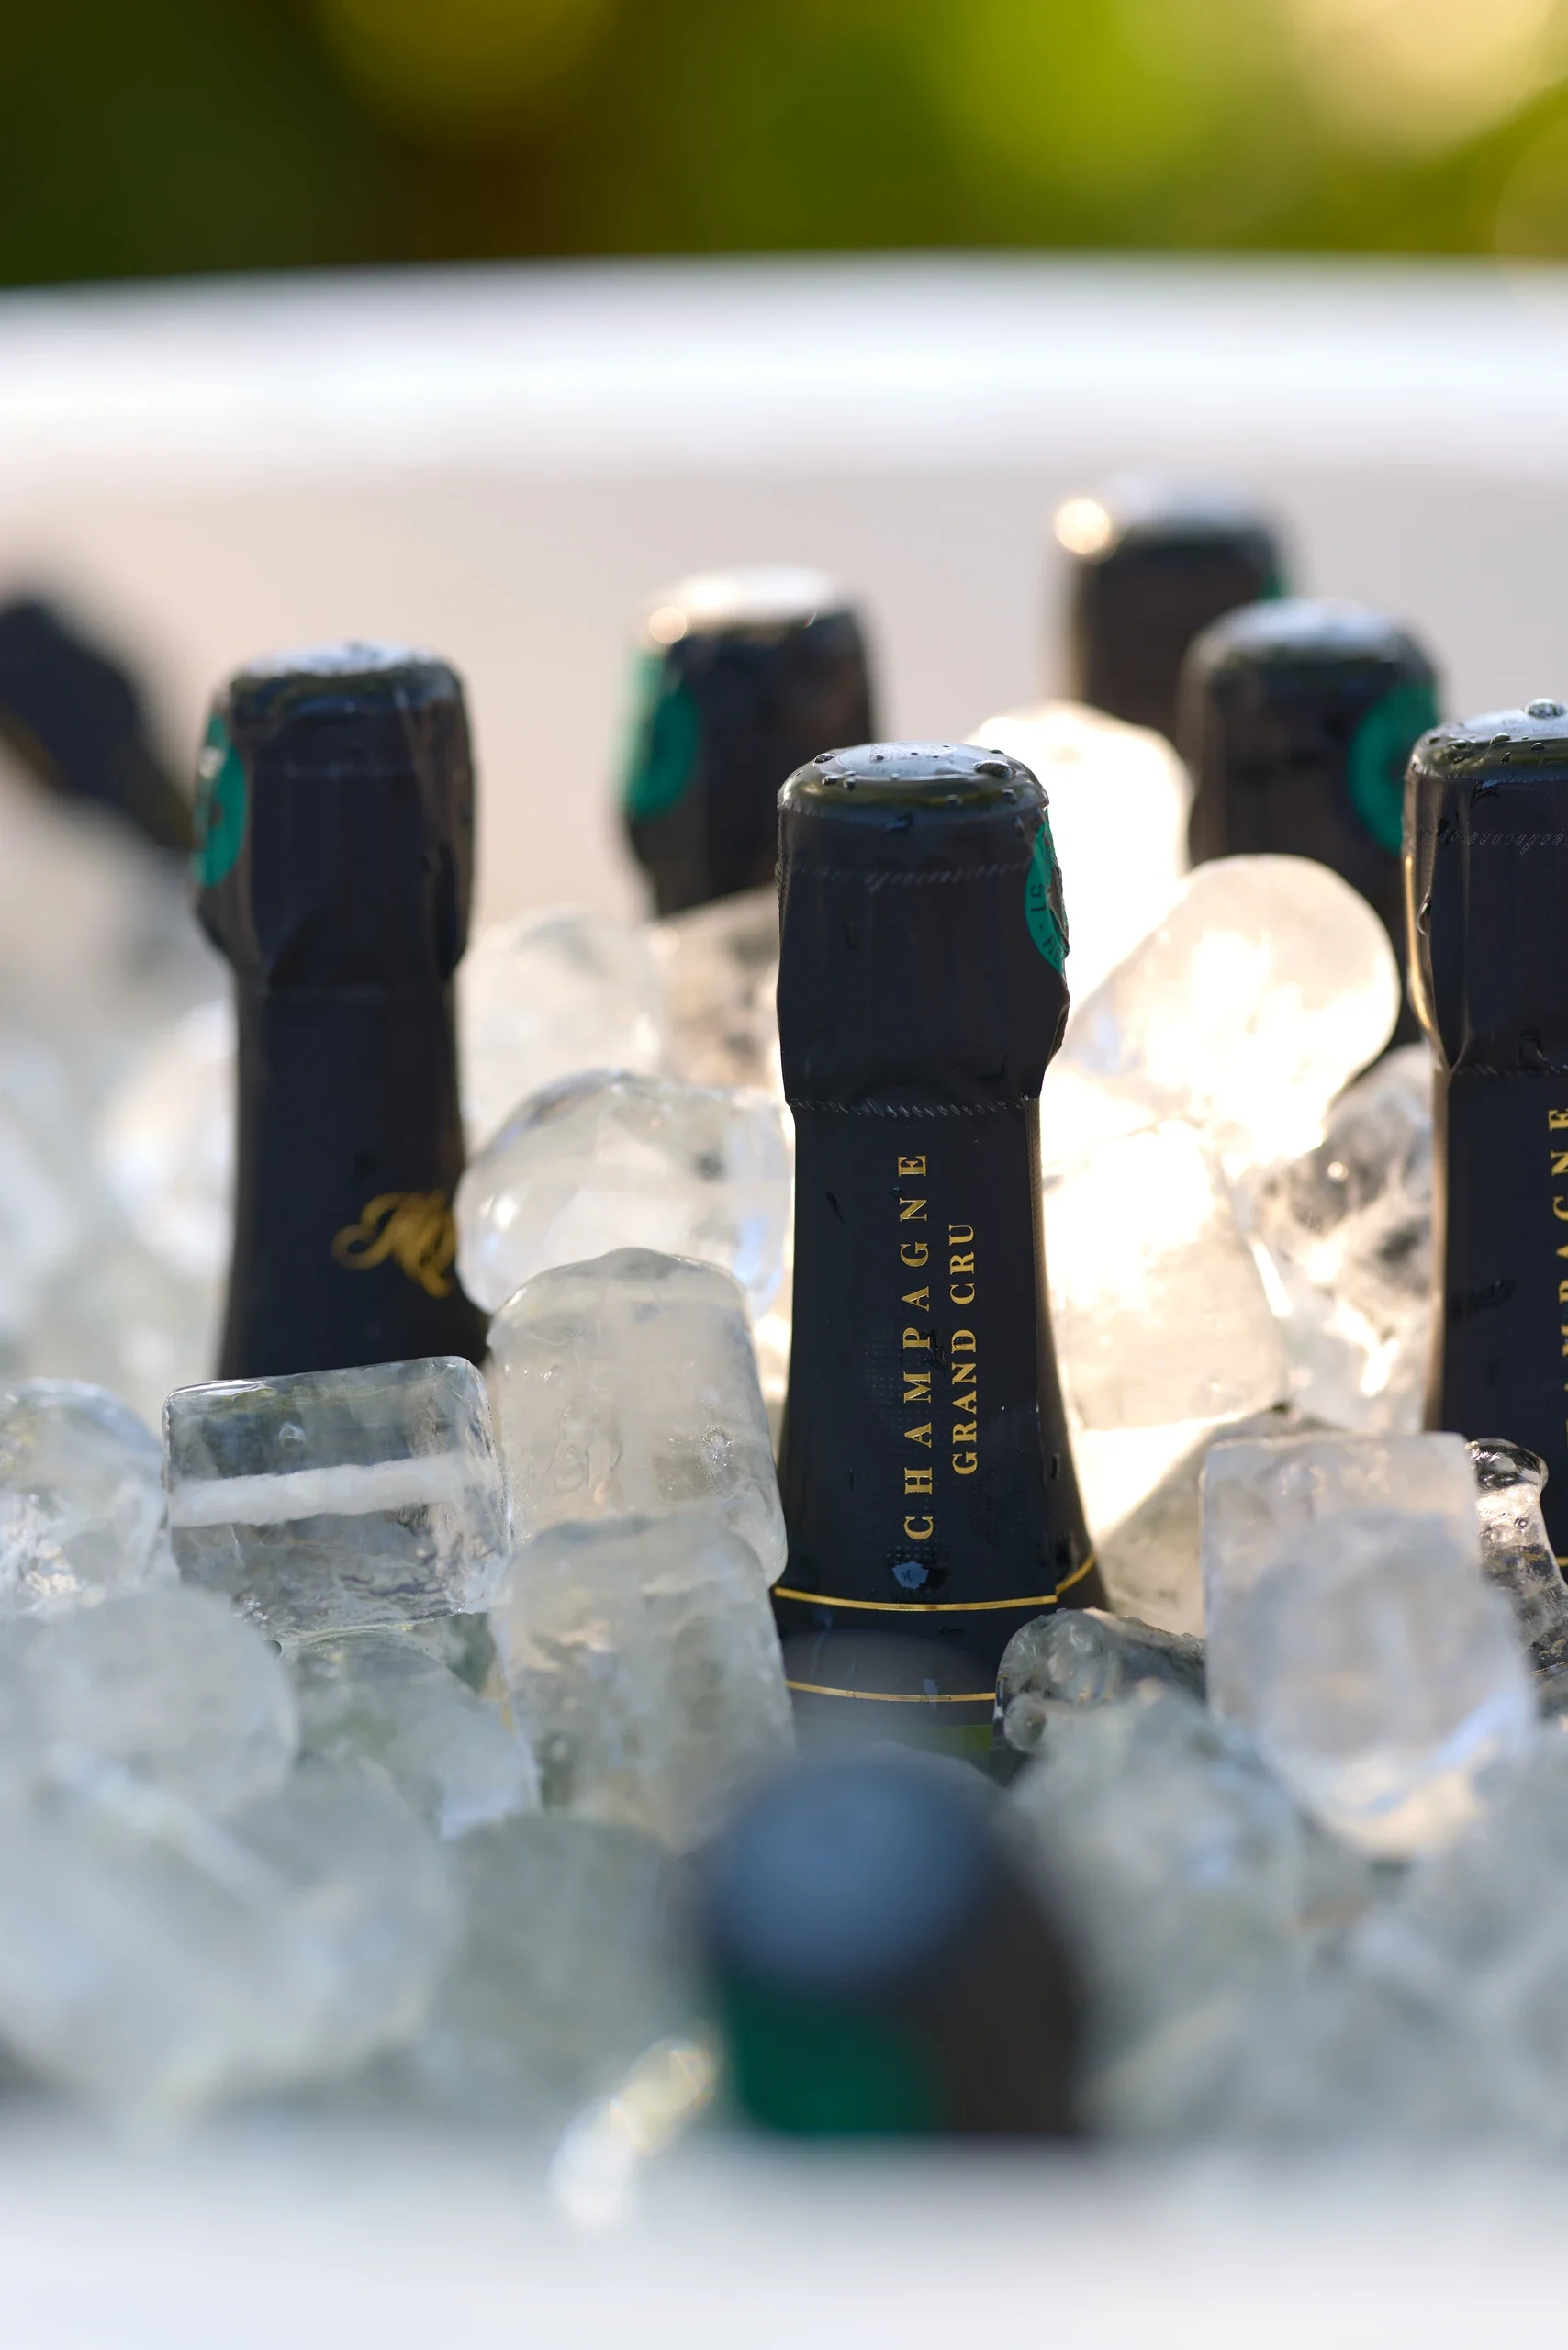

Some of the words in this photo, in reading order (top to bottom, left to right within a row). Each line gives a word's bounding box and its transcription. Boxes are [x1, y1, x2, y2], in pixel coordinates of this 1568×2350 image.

[948, 1223, 977, 1306] CRU
[897, 1155, 935, 1541] CHAMPAGNE
[951, 1328, 979, 1476] GRAND
